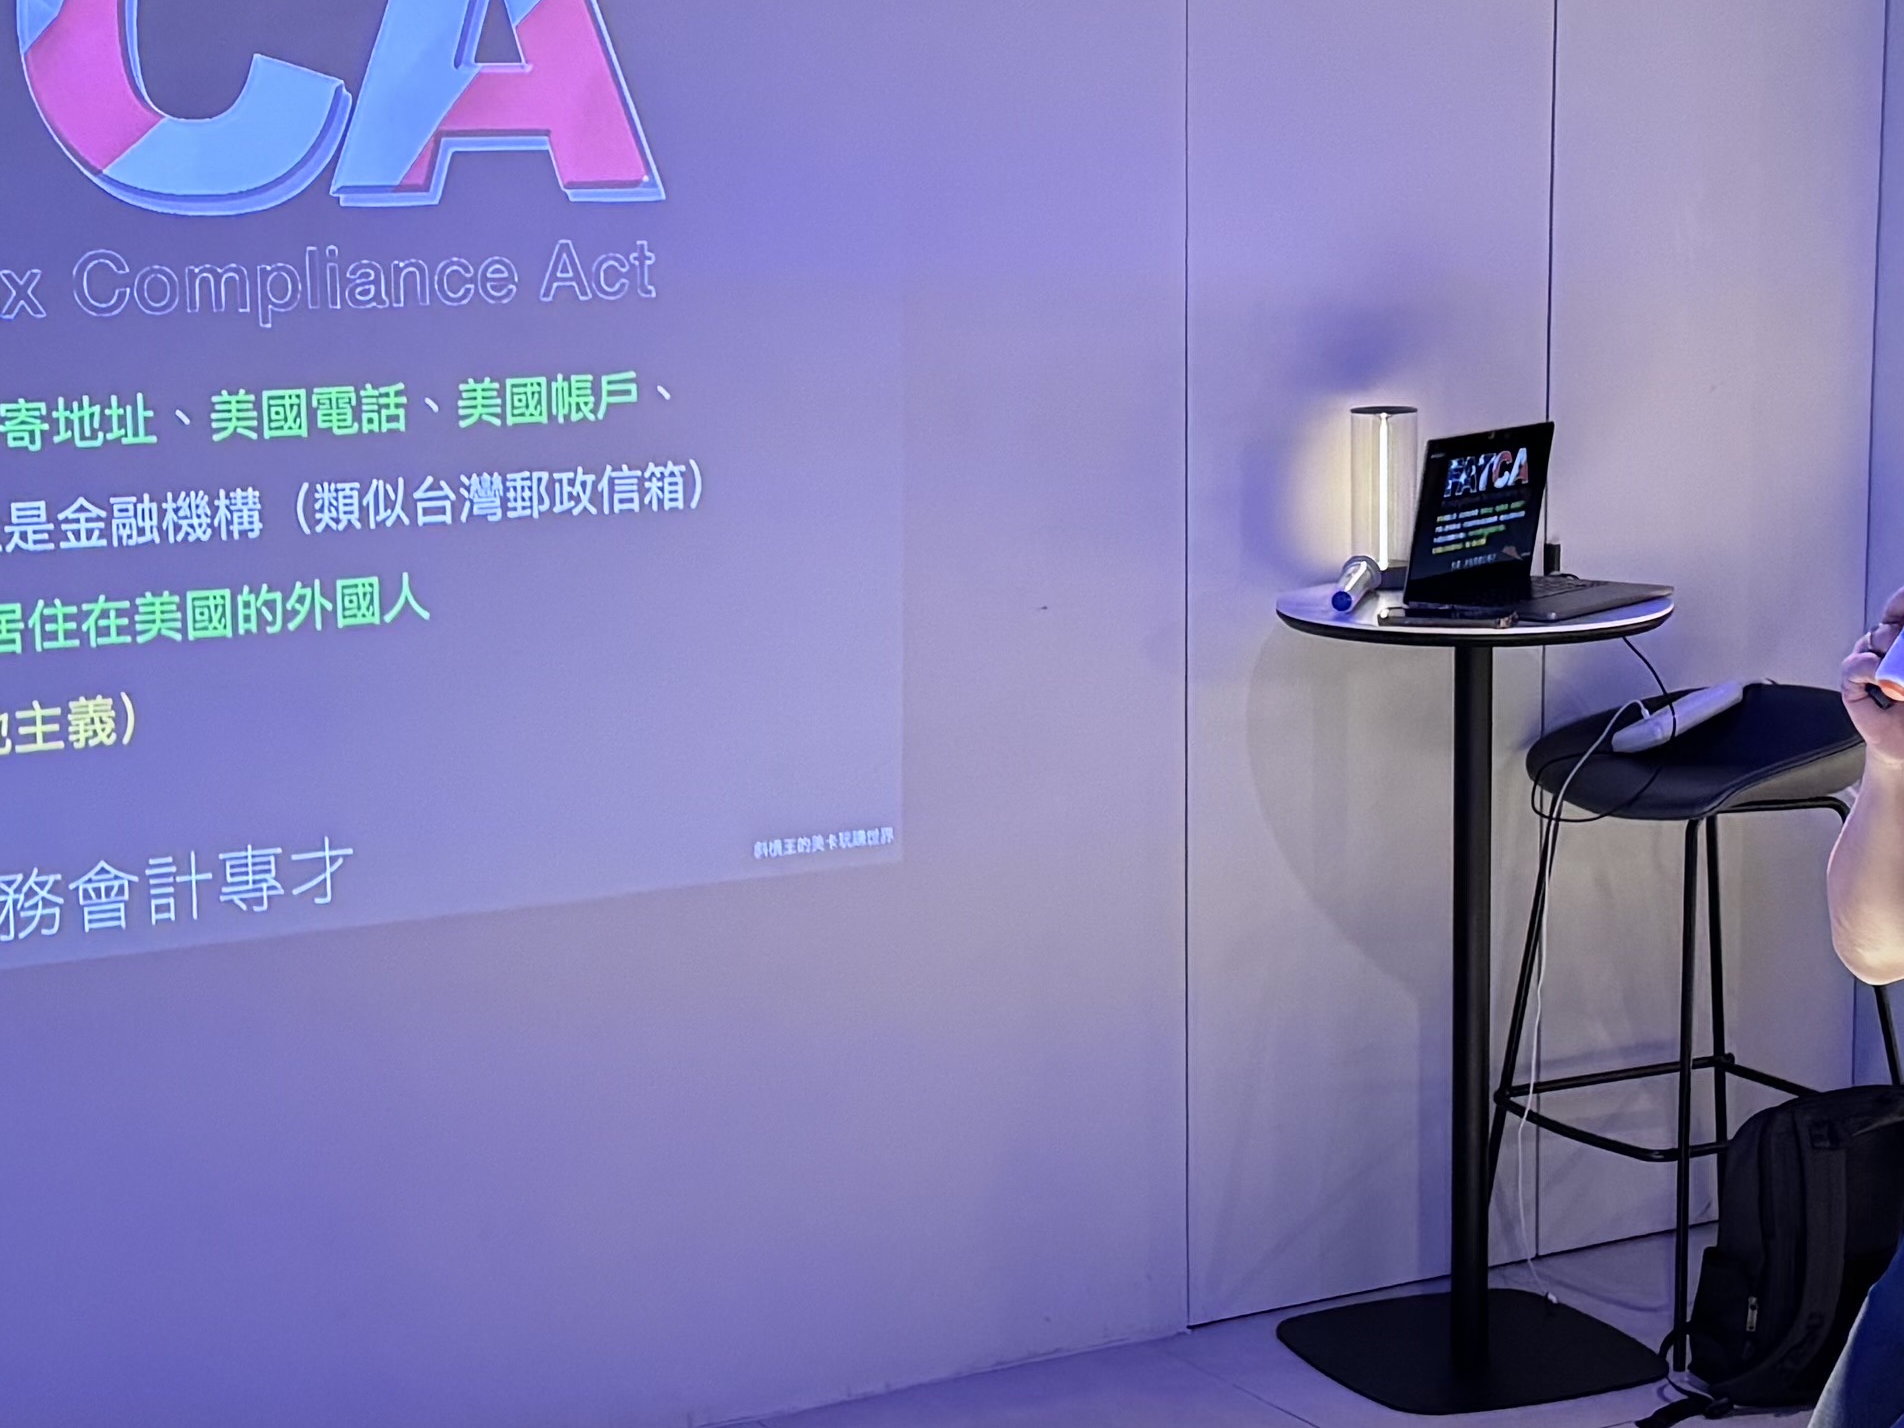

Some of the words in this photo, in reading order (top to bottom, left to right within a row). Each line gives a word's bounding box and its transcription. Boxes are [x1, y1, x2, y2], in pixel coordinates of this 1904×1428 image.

[72, 243, 519, 328] Compliance
[540, 239, 658, 303] Act
[1443, 447, 1528, 498] FATCA
